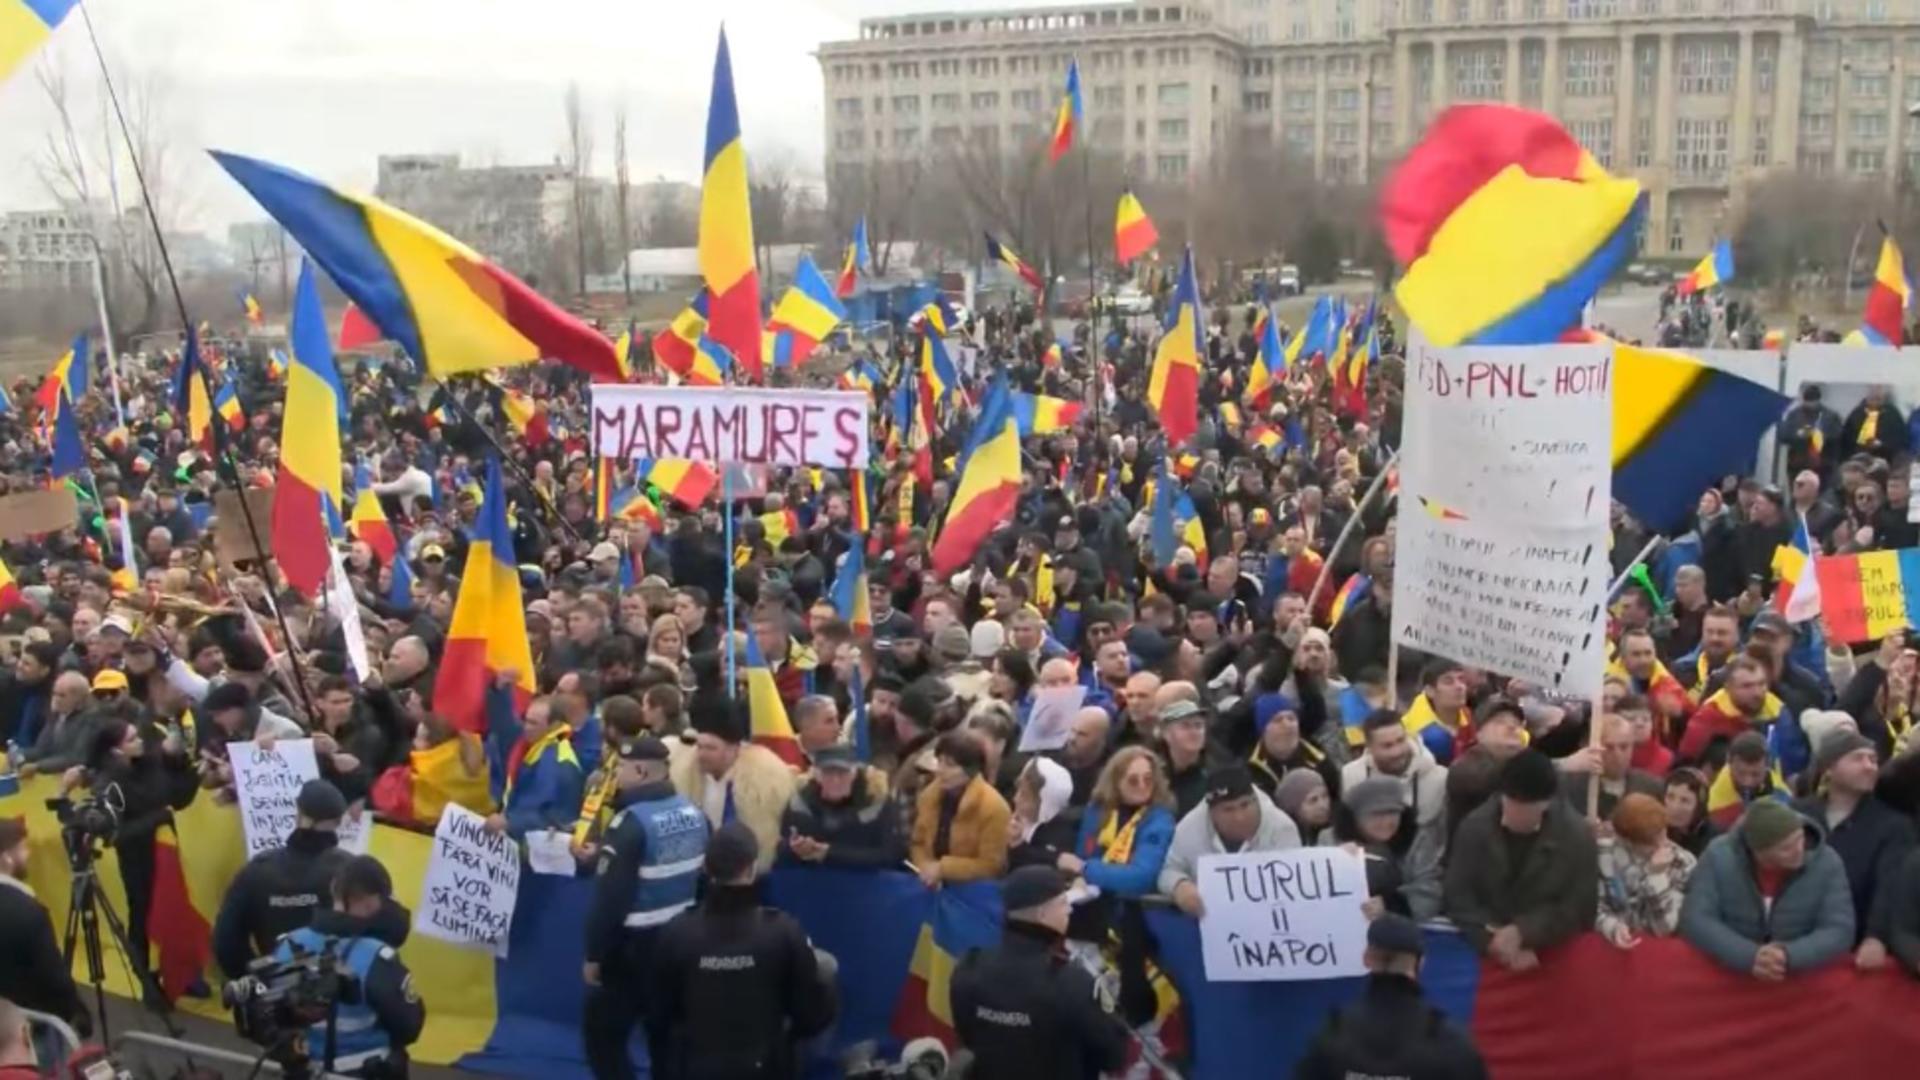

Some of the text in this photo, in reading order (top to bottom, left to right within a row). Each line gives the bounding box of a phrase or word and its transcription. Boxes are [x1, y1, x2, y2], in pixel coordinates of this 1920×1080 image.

[594, 402, 862, 468] MARAMUREȘ
[453, 871, 492, 903] VOR
[1214, 857, 1353, 903] TURUL
[453, 895, 470, 919] SE
